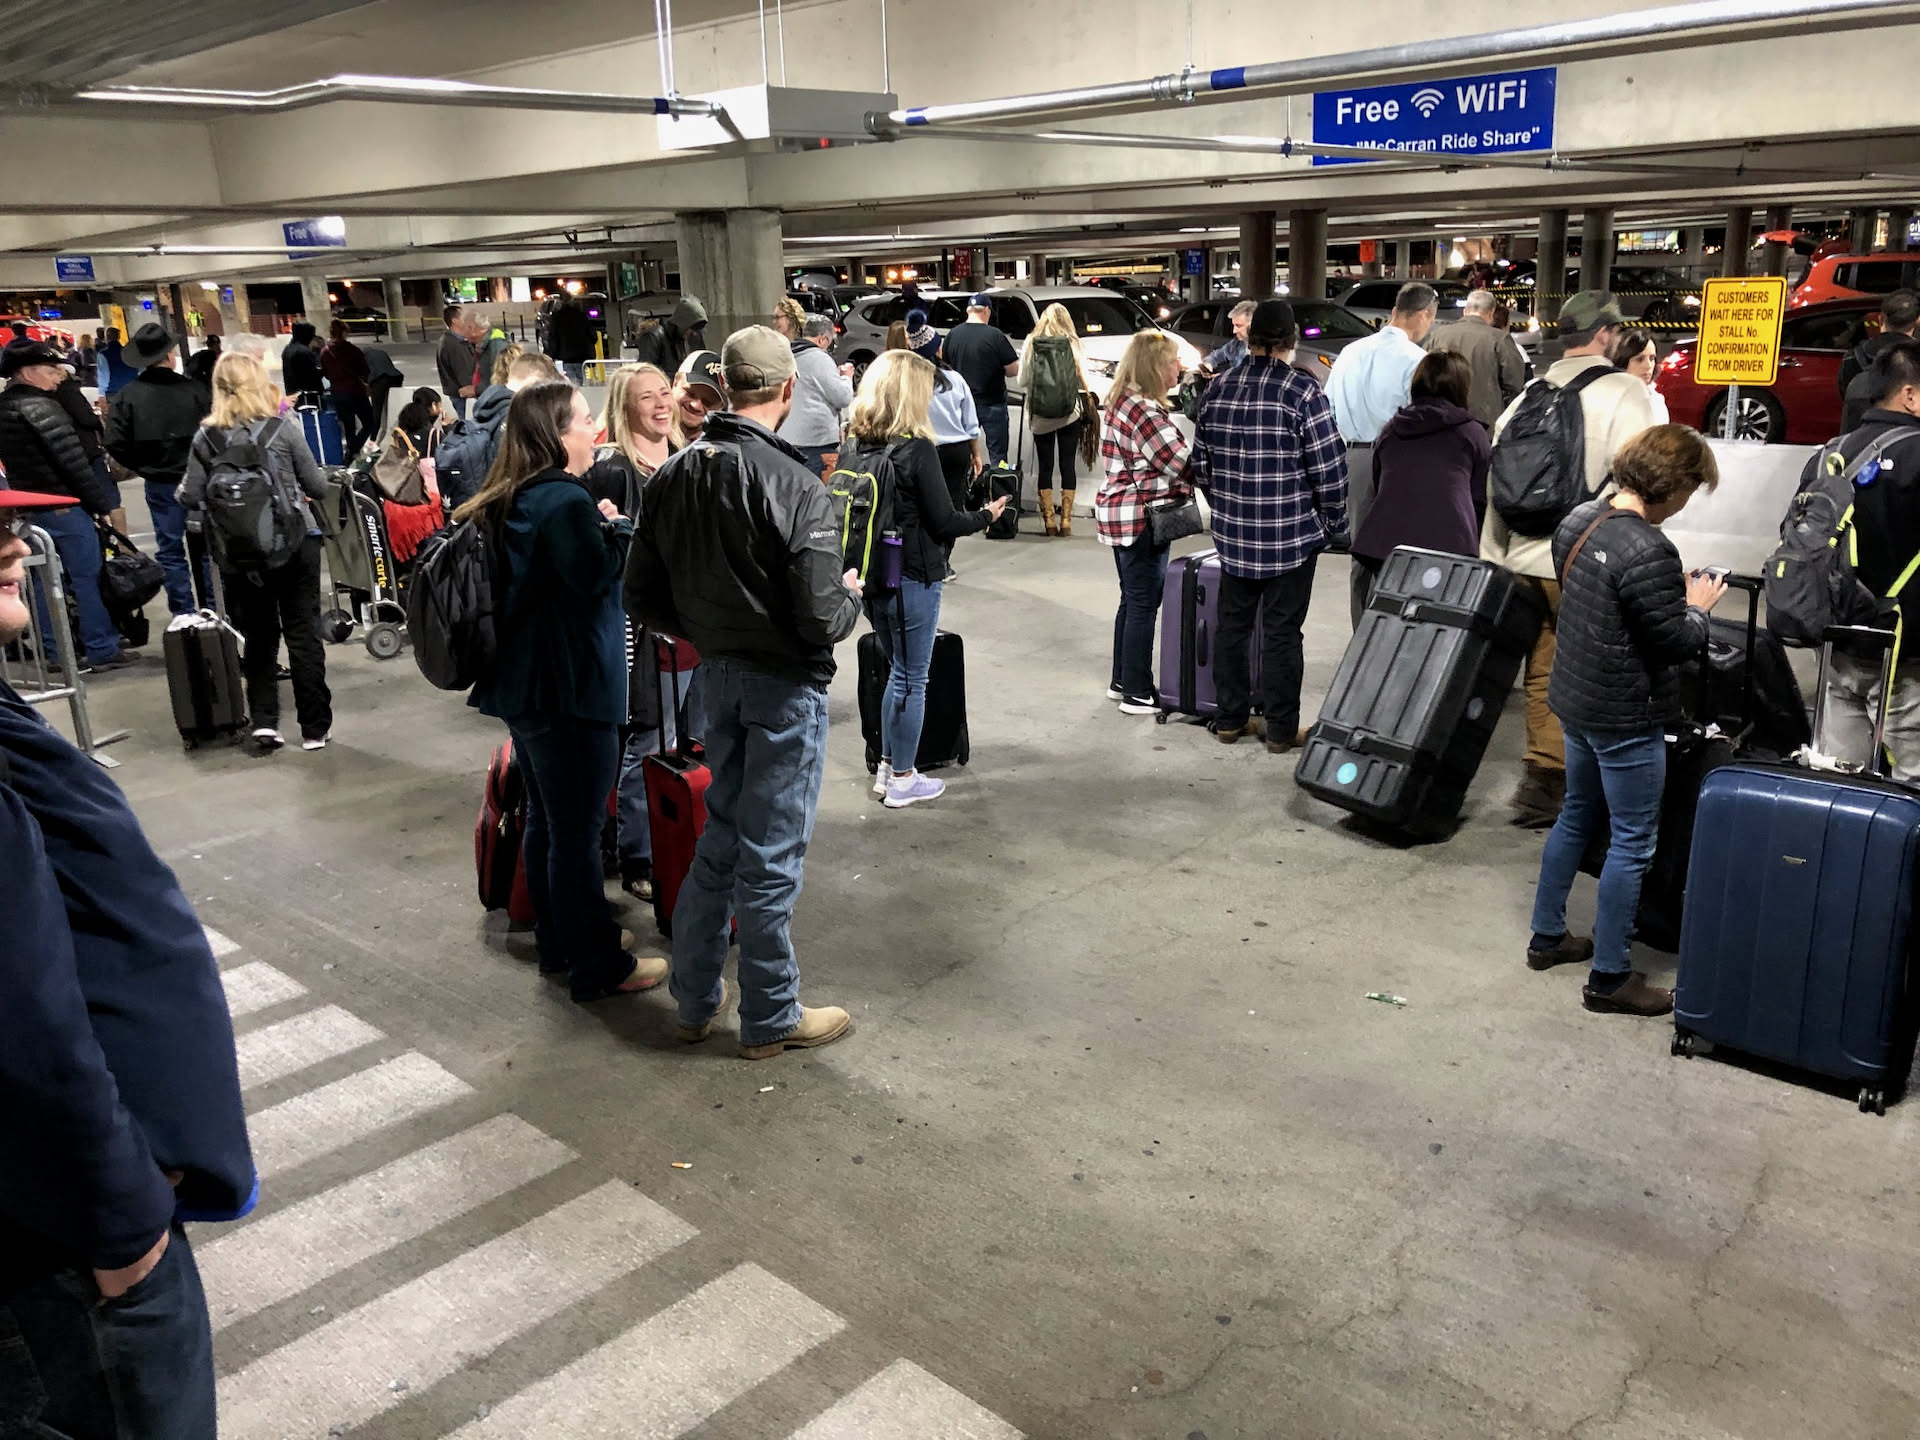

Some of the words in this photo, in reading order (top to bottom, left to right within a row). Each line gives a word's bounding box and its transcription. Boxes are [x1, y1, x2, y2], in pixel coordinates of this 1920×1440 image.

[1336, 97, 1400, 125] Free
[1456, 79, 1527, 115] WiFi
[1441, 129, 1478, 150] Ride
[1482, 126, 1541, 146] Share"
[1717, 291, 1769, 304] CUSTOMERS
[1710, 309, 1729, 320] WAIT
[1731, 309, 1754, 320] HERE
[1756, 309, 1774, 320] FOR
[1719, 326, 1744, 338] STALL
[1707, 343, 1769, 355] CONFIRMATION
[1708, 360, 1731, 371] FROM
[1733, 360, 1764, 372] DRIVER
